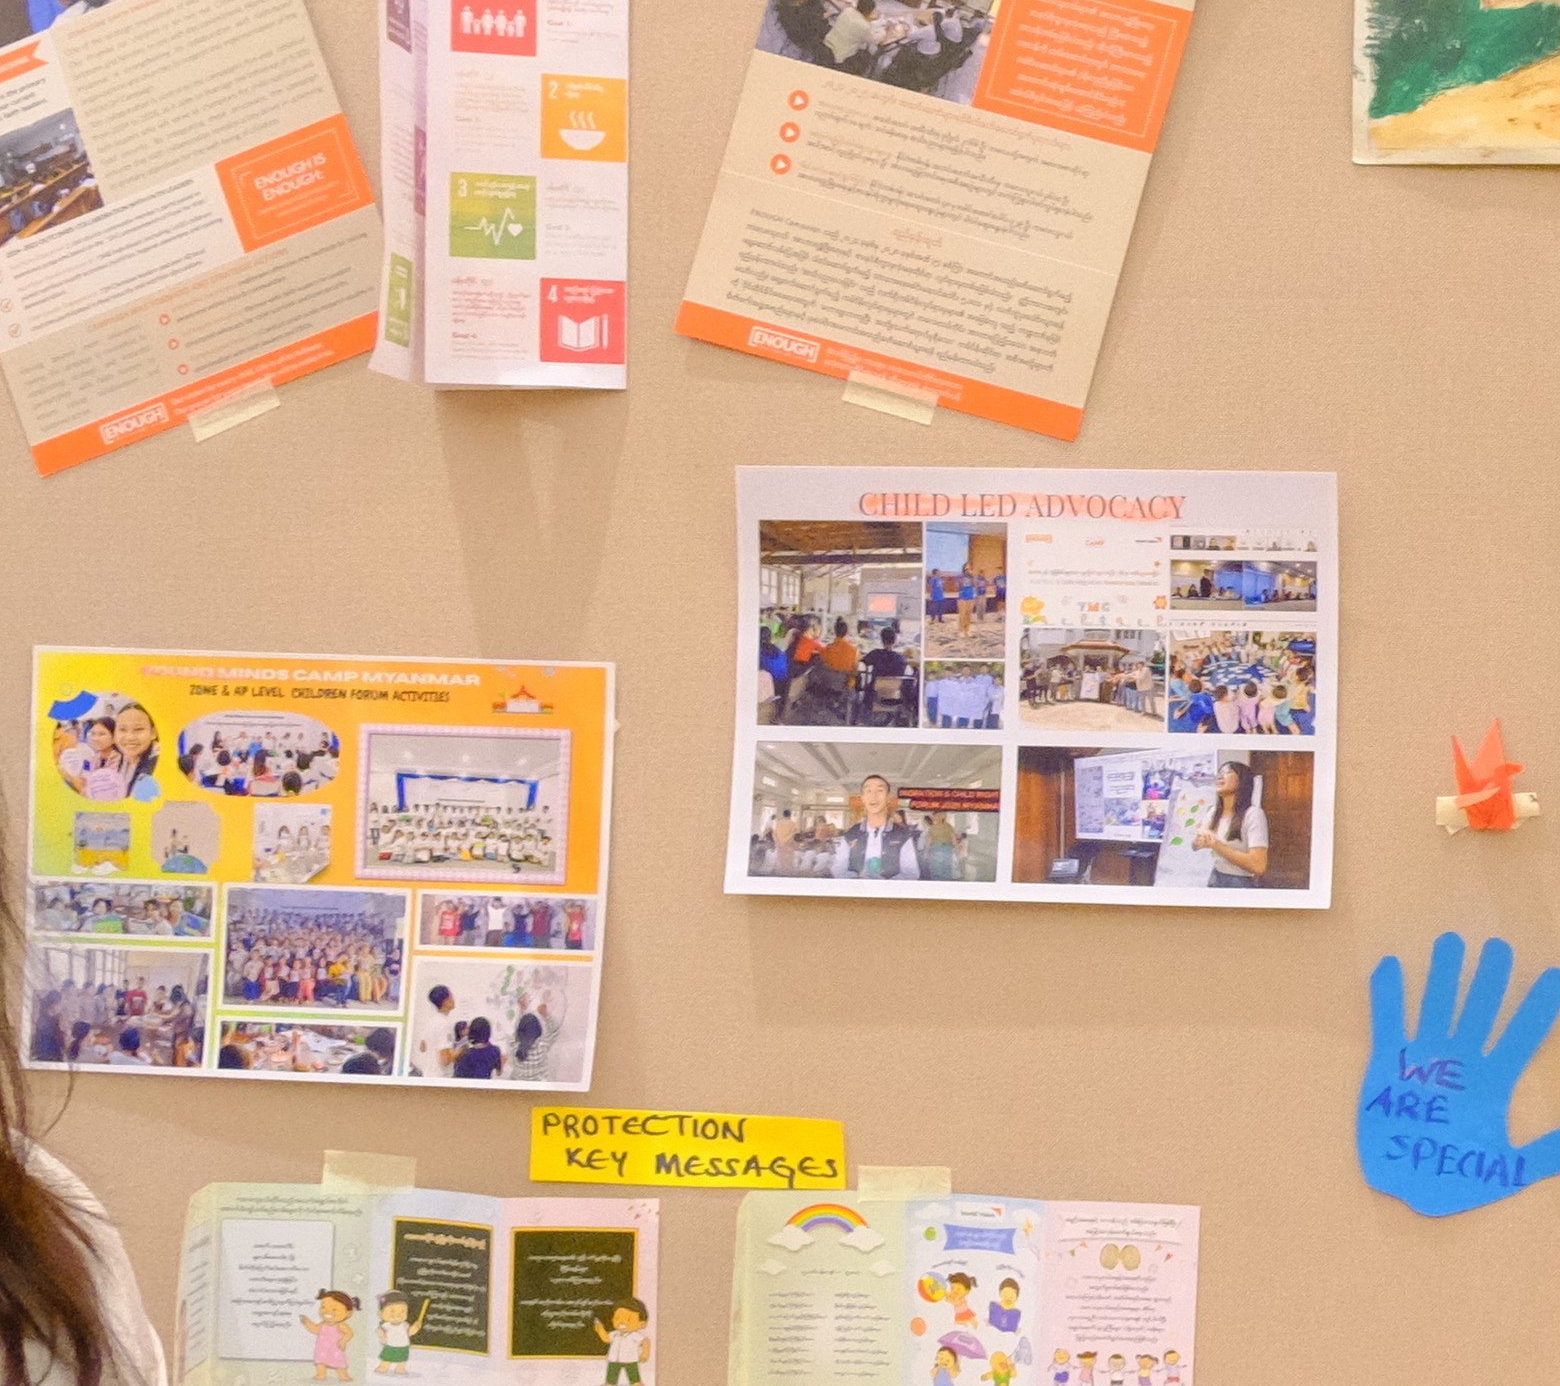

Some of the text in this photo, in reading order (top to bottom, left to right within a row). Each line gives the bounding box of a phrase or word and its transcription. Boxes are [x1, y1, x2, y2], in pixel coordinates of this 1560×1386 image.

[548, 80, 559, 99] 2
[254, 153, 327, 191] ENOUGH IS
[457, 178, 468, 198] 3
[546, 284, 559, 303] 4
[752, 329, 819, 361] ENOUGH
[102, 406, 167, 443] ENOUGH
[858, 492, 1187, 521] CHILD LED ADVOCACY
[143, 665, 481, 687] YOUNG MINDS CAMP MYANMAR
[251, 686, 285, 699] LEVEL
[291, 687, 347, 700] CHILDREN
[350, 689, 389, 702] FORUM
[392, 690, 451, 703] ACTIVITIES
[1399, 1047, 1467, 1091] WE
[1365, 1085, 1451, 1125] ARE
[542, 1112, 748, 1144] PROTECTION
[565, 1146, 840, 1190] KEY MESSAGES
[1386, 1134, 1527, 1188] SPECIAL
